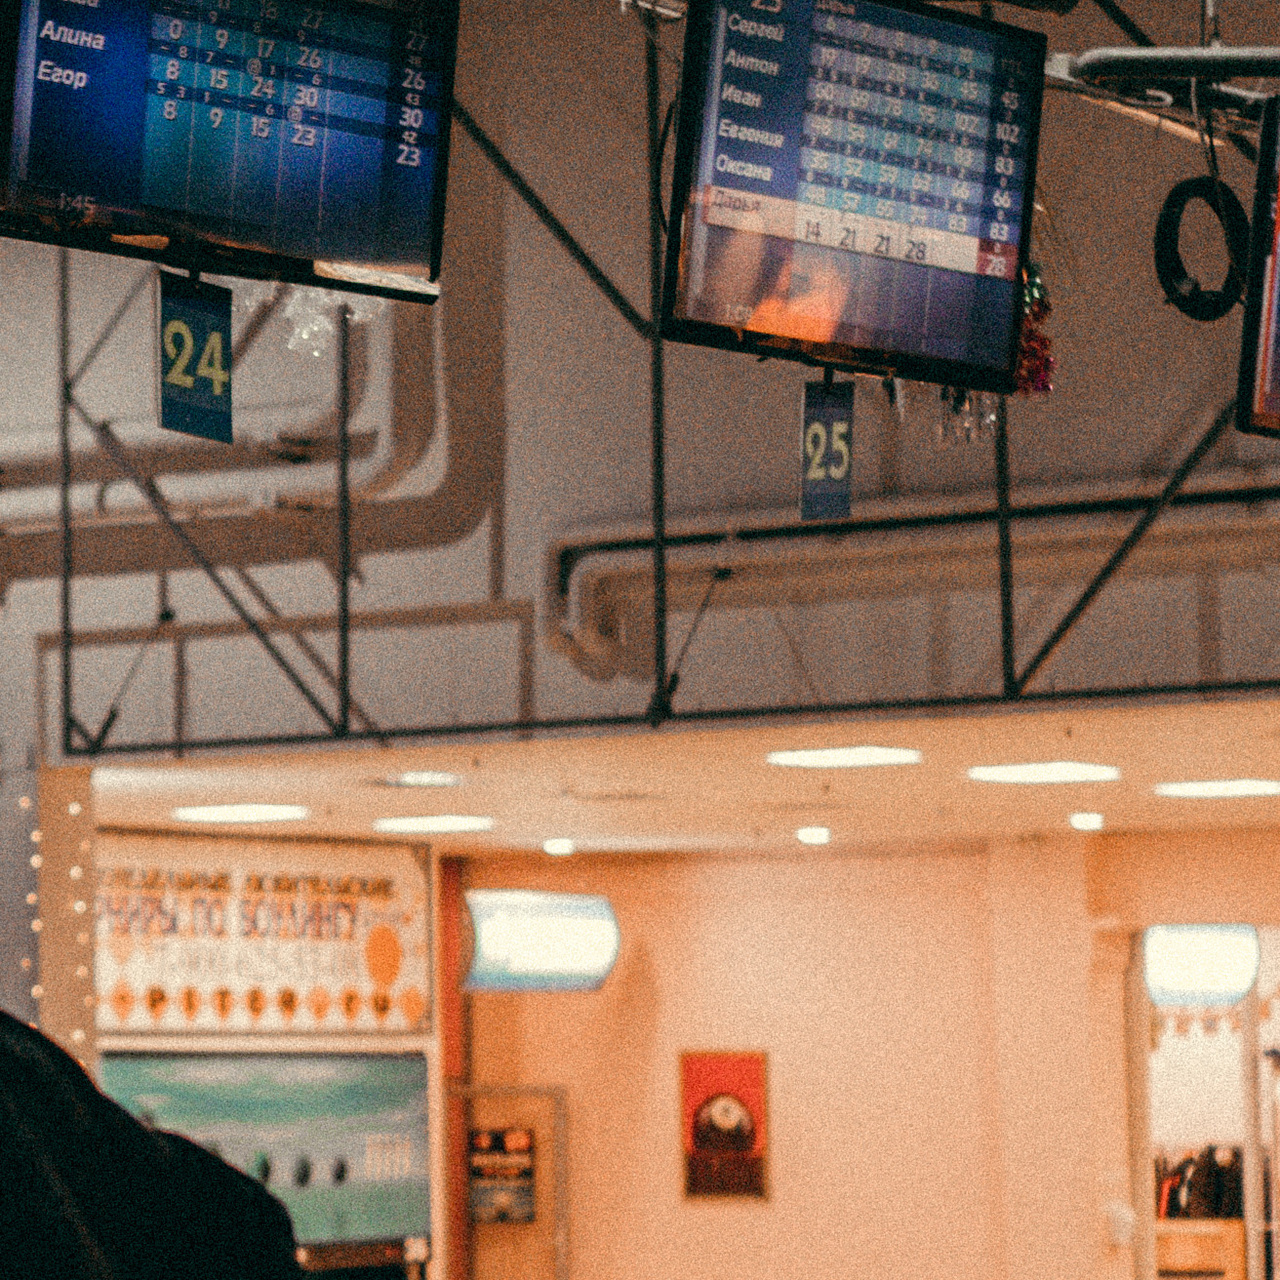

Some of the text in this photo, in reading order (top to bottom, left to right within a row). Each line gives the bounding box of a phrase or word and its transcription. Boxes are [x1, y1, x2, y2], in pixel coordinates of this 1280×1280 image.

[39, 20, 106, 51] Алина
[169, 19, 426, 90] 0 9 17 26 26
[37, 59, 89, 91] Егор
[725, 49, 779, 76] Антон
[166, 59, 423, 128] 8 15 24 30 30
[722, 83, 761, 108] Иван
[164, 100, 422, 167] 8 9 15 23 23
[840, 227, 856, 248] 21
[875, 233, 890, 254] 21
[906, 239, 926, 261] 28
[163, 319, 229, 397] 24
[805, 421, 850, 481] 25
